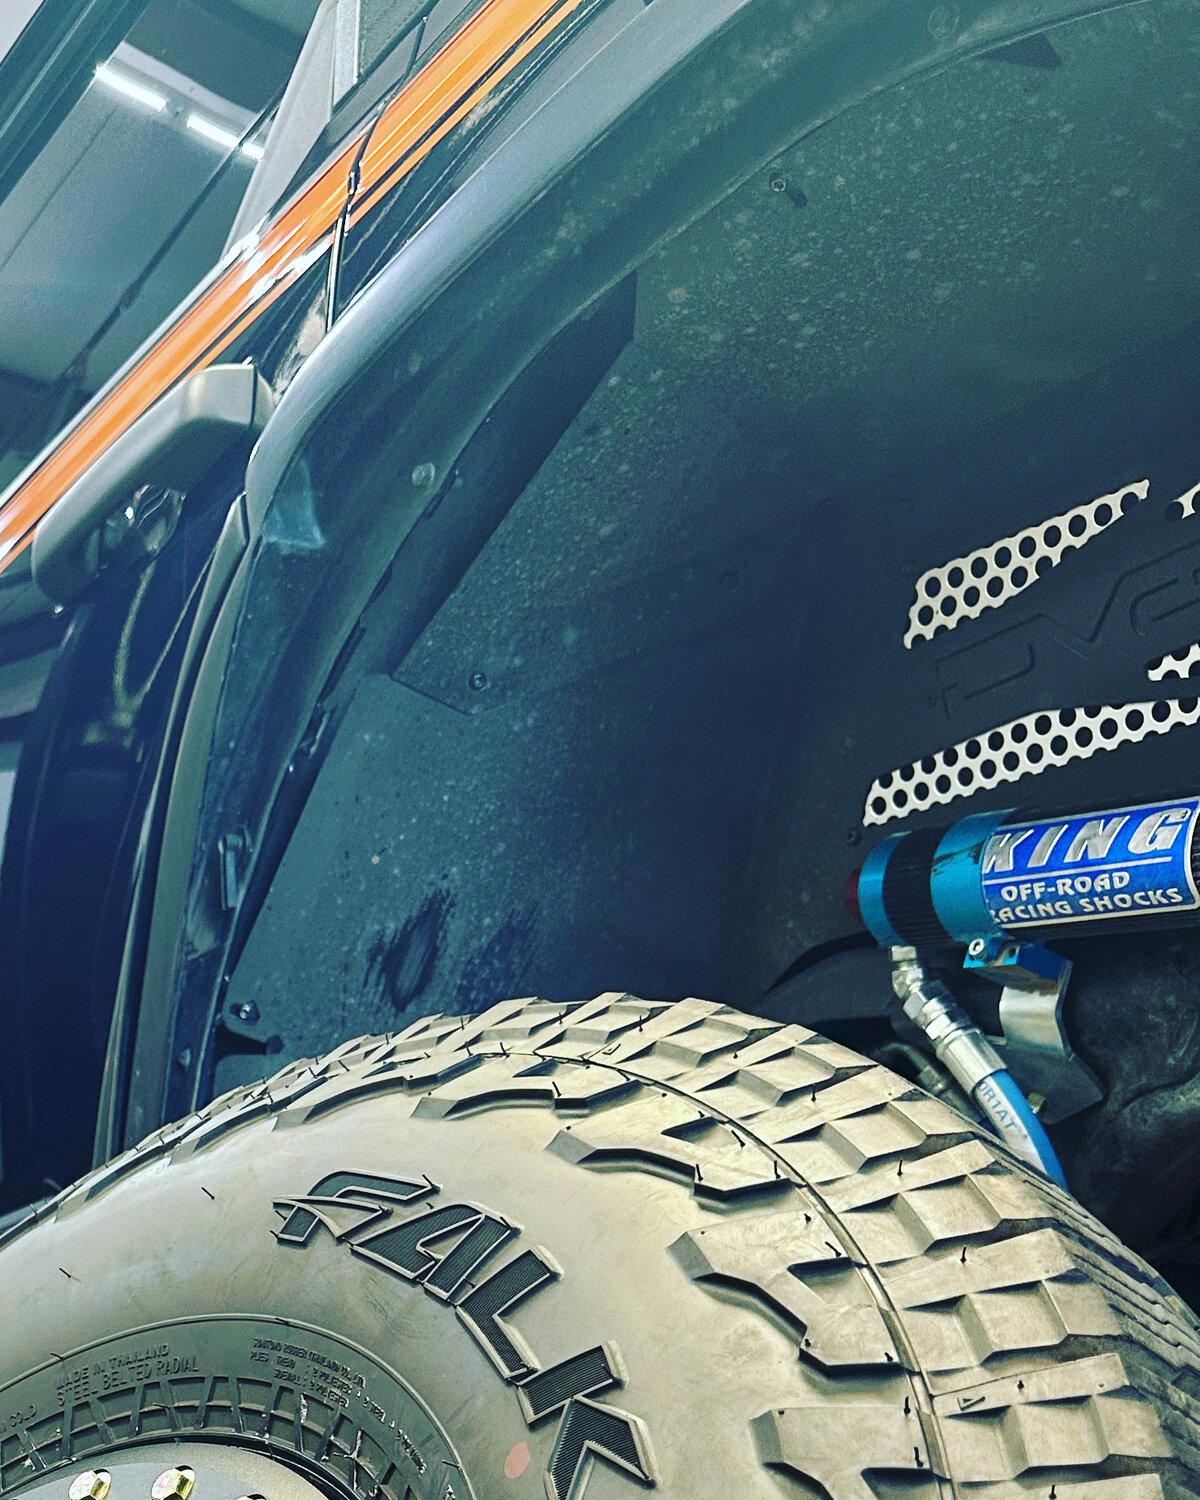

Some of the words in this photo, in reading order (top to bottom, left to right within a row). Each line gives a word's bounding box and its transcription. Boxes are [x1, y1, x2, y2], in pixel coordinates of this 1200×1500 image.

[981, 807, 1192, 874] KING
[1001, 871, 1131, 903] OFF-ROAD
[1082, 887, 1184, 913] SHOCKS
[9, 1404, 37, 1428] COLD
